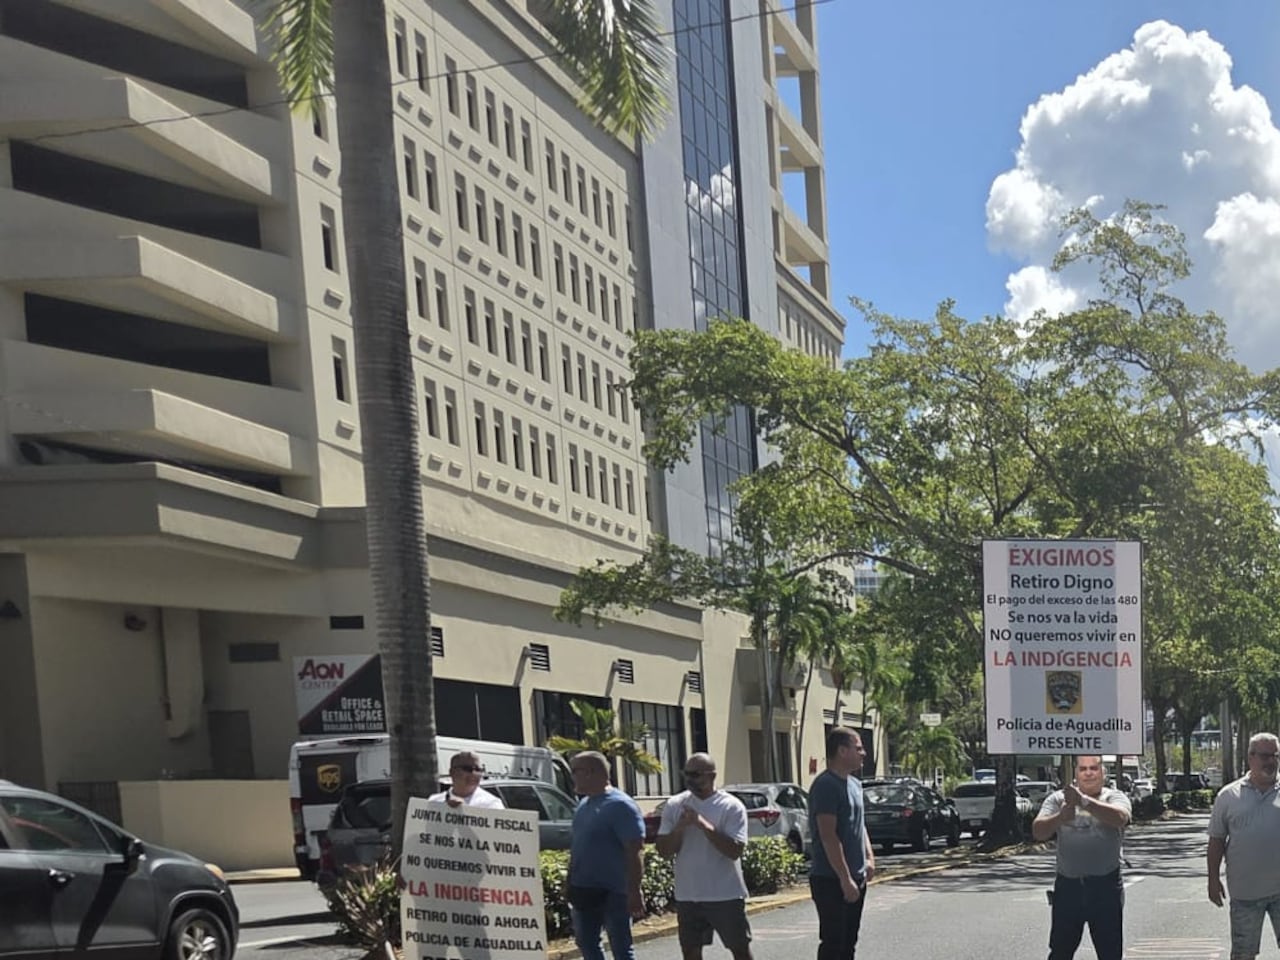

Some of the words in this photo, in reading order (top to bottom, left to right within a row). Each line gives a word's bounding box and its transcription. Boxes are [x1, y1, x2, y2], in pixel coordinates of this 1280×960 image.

[1009, 548, 1114, 566] EXIGIMOS
[1010, 574, 1060, 589] Retiro
[1064, 574, 1114, 592] Digno
[987, 595, 996, 604] El
[1000, 597, 1026, 608] pago
[1028, 595, 1045, 604] del
[1086, 595, 1098, 604] de
[1101, 595, 1116, 604] las
[1118, 596, 1138, 604] 480
[1008, 612, 1024, 623] Se
[1027, 614, 1052, 623] nos
[1054, 614, 1071, 623] va
[1074, 612, 1086, 623] la
[1088, 612, 1118, 624] vida
[990, 629, 1012, 641] NO
[1014, 632, 1083, 644] queremos
[1086, 630, 1116, 641] vivir
[1120, 632, 1136, 641] en
[994, 651, 1017, 666] LA
[1022, 651, 1132, 667] INDIGENCIA
[354, 709, 383, 721] SPACE
[997, 718, 1042, 731] Policia
[1046, 719, 1062, 730] de
[1066, 719, 1132, 734] Aguadilla
[1028, 737, 1101, 749] PRESENTE
[412, 809, 442, 822] JUNTA
[445, 813, 490, 828] CONTROL
[494, 819, 533, 832] FISCAL
[420, 833, 431, 844] SE
[434, 835, 454, 848] NOS
[458, 838, 472, 850] VA
[476, 840, 489, 851] LA
[494, 842, 520, 854] VIDA
[407, 855, 420, 866] NO
[424, 858, 482, 874] QUEREMOS
[486, 864, 516, 876] VIVIR
[520, 868, 536, 878] EN
[408, 880, 429, 896] LA
[435, 883, 534, 906] INDIGENCIA
[407, 908, 447, 922] RETIRO
[452, 913, 490, 926] DIGNO
[494, 916, 539, 929] AHORA
[406, 931, 450, 946] POLICIA
[454, 936, 470, 948] DE
[474, 938, 544, 951] AGUADILLA
